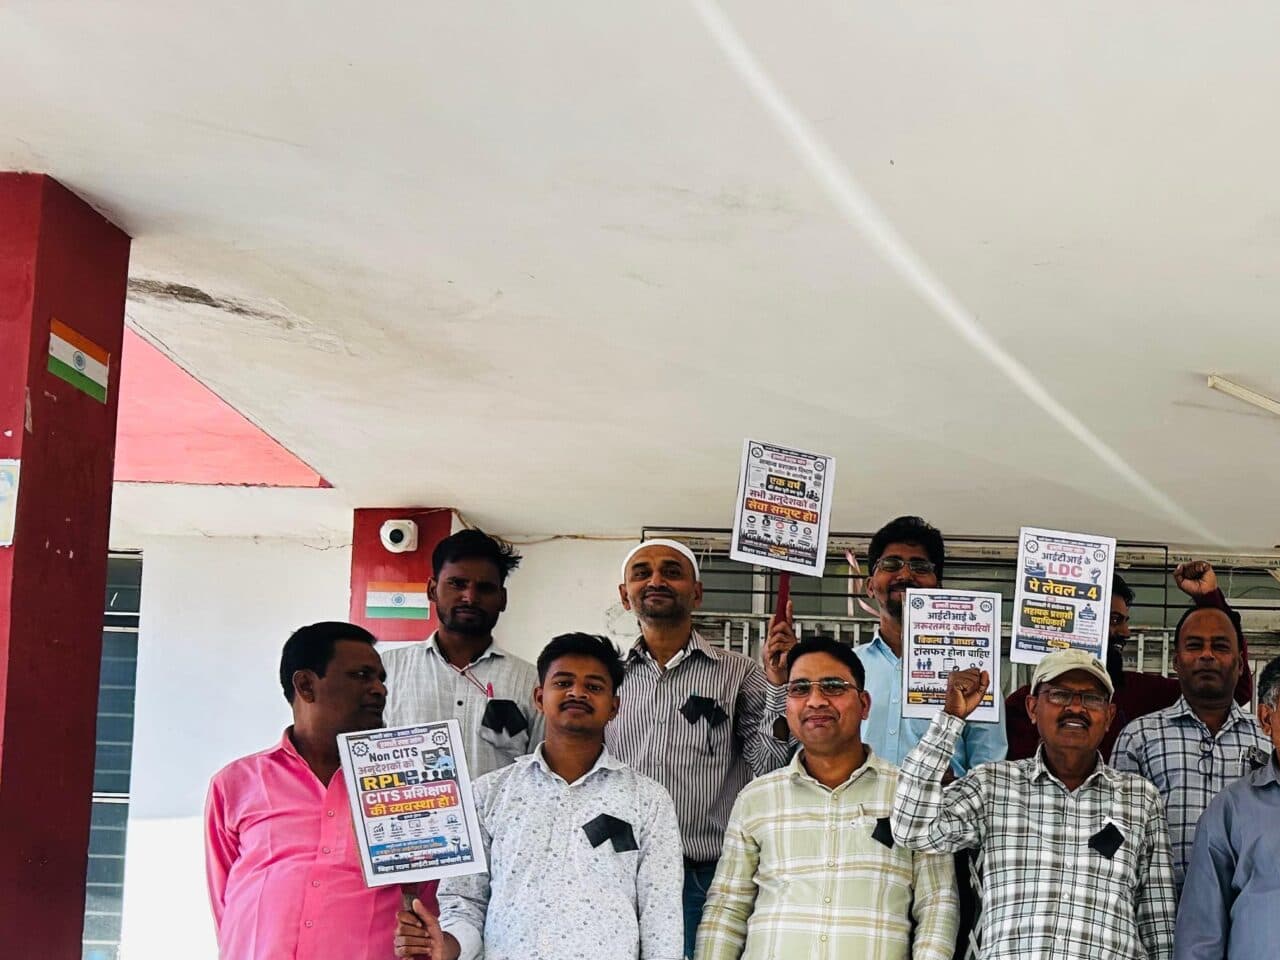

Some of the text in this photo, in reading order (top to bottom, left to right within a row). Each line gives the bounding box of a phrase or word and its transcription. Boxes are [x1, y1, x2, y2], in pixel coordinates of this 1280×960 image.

[769, 476, 801, 490] एक वर्ष
[749, 488, 766, 498] सभी
[768, 492, 807, 508] अनुदेशकों
[748, 500, 768, 512] सेवा
[771, 505, 802, 520] सम्पुष्ट
[803, 512, 816, 522] हो!
[1042, 552, 1091, 565] आईटीआई के
[1048, 563, 1082, 577] LDC
[1029, 578, 1040, 592] पे
[1042, 580, 1076, 596] लेवल
[1087, 587, 1097, 599] 4
[928, 611, 977, 623] आईटीआई के
[913, 622, 990, 633] जरूरतमंद कर्मचारियों
[914, 647, 990, 659] ट्रांसफर होना चाहिए
[369, 747, 418, 763] Non CITS
[357, 761, 401, 777] अनुदेशकों
[403, 759, 414, 768] को
[363, 775, 406, 790] RPL
[366, 784, 452, 805] CITS प्रशिक्षण
[369, 804, 386, 817] की
[389, 799, 435, 813] व्यवस्था
